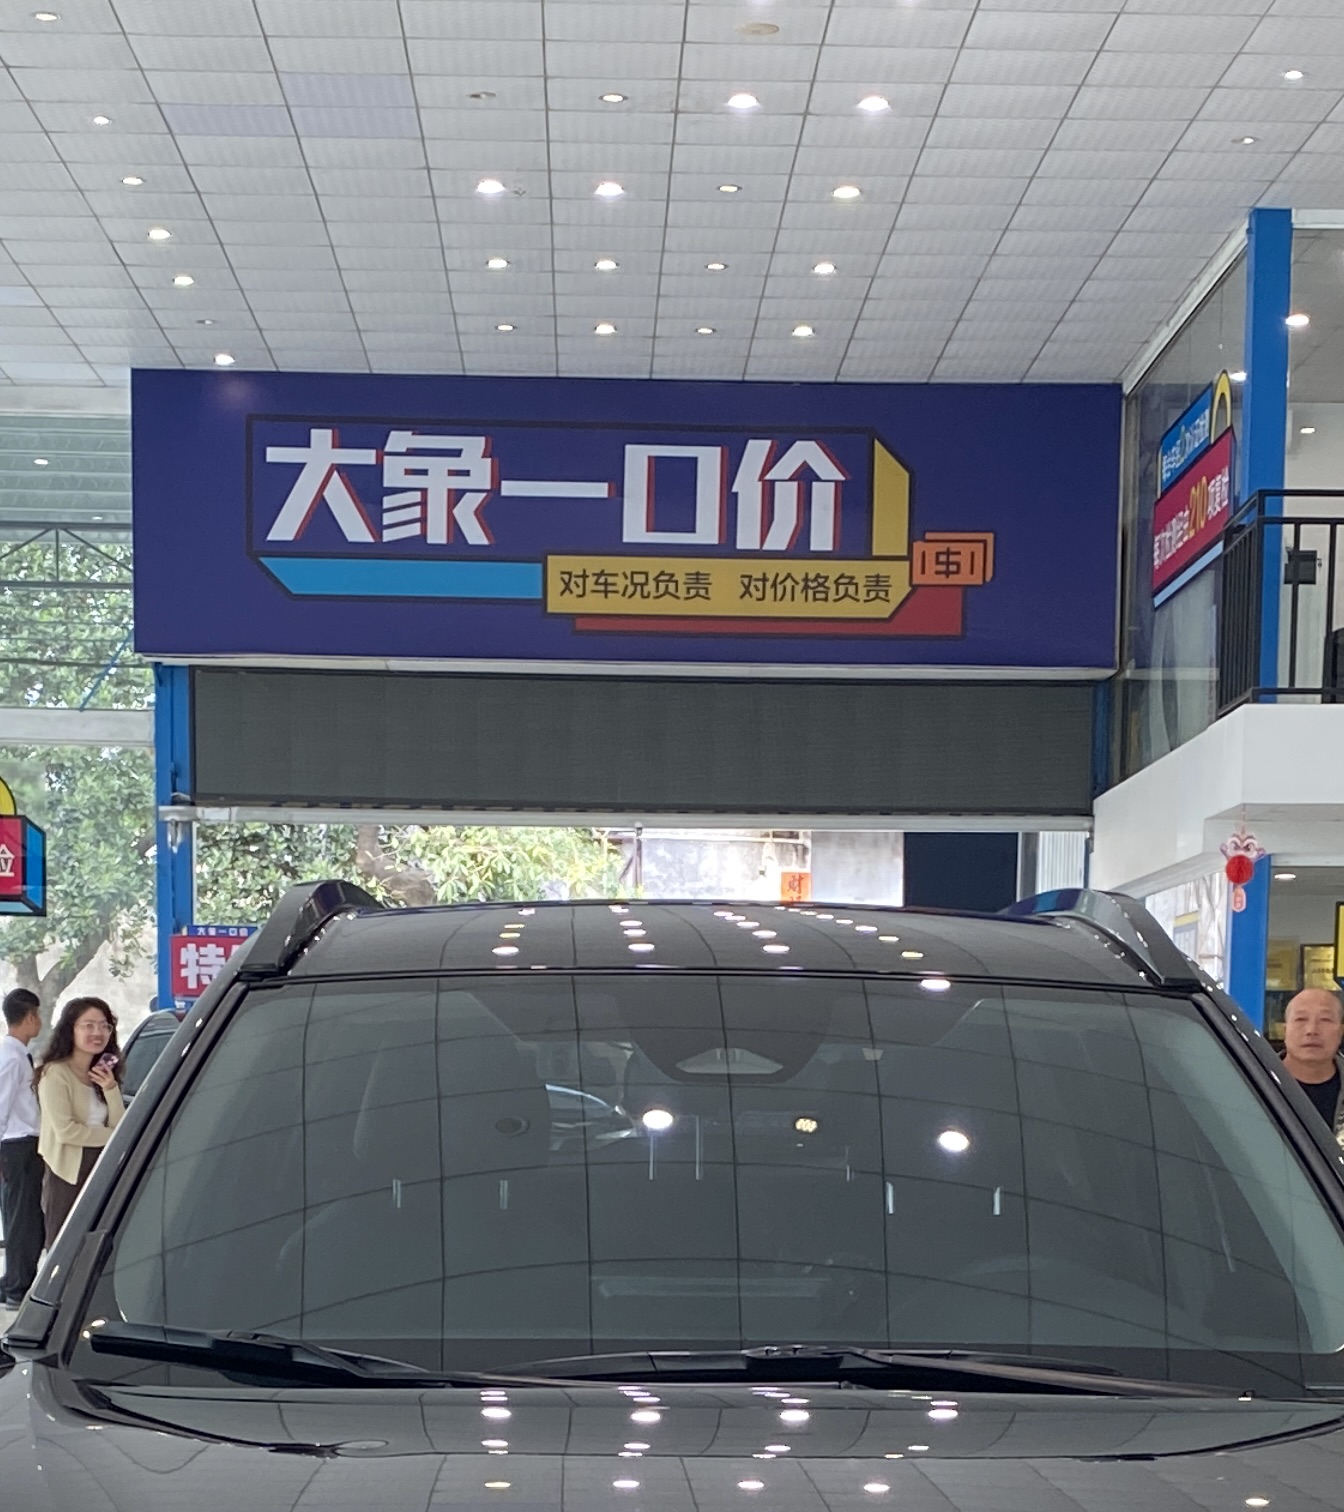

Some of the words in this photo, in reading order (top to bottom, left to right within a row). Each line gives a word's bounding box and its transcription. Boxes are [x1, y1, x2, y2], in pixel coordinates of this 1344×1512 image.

[264, 427, 848, 552] 大象一口价
[560, 568, 713, 601] 对车况负责
[739, 571, 893, 604] 对价格负责
